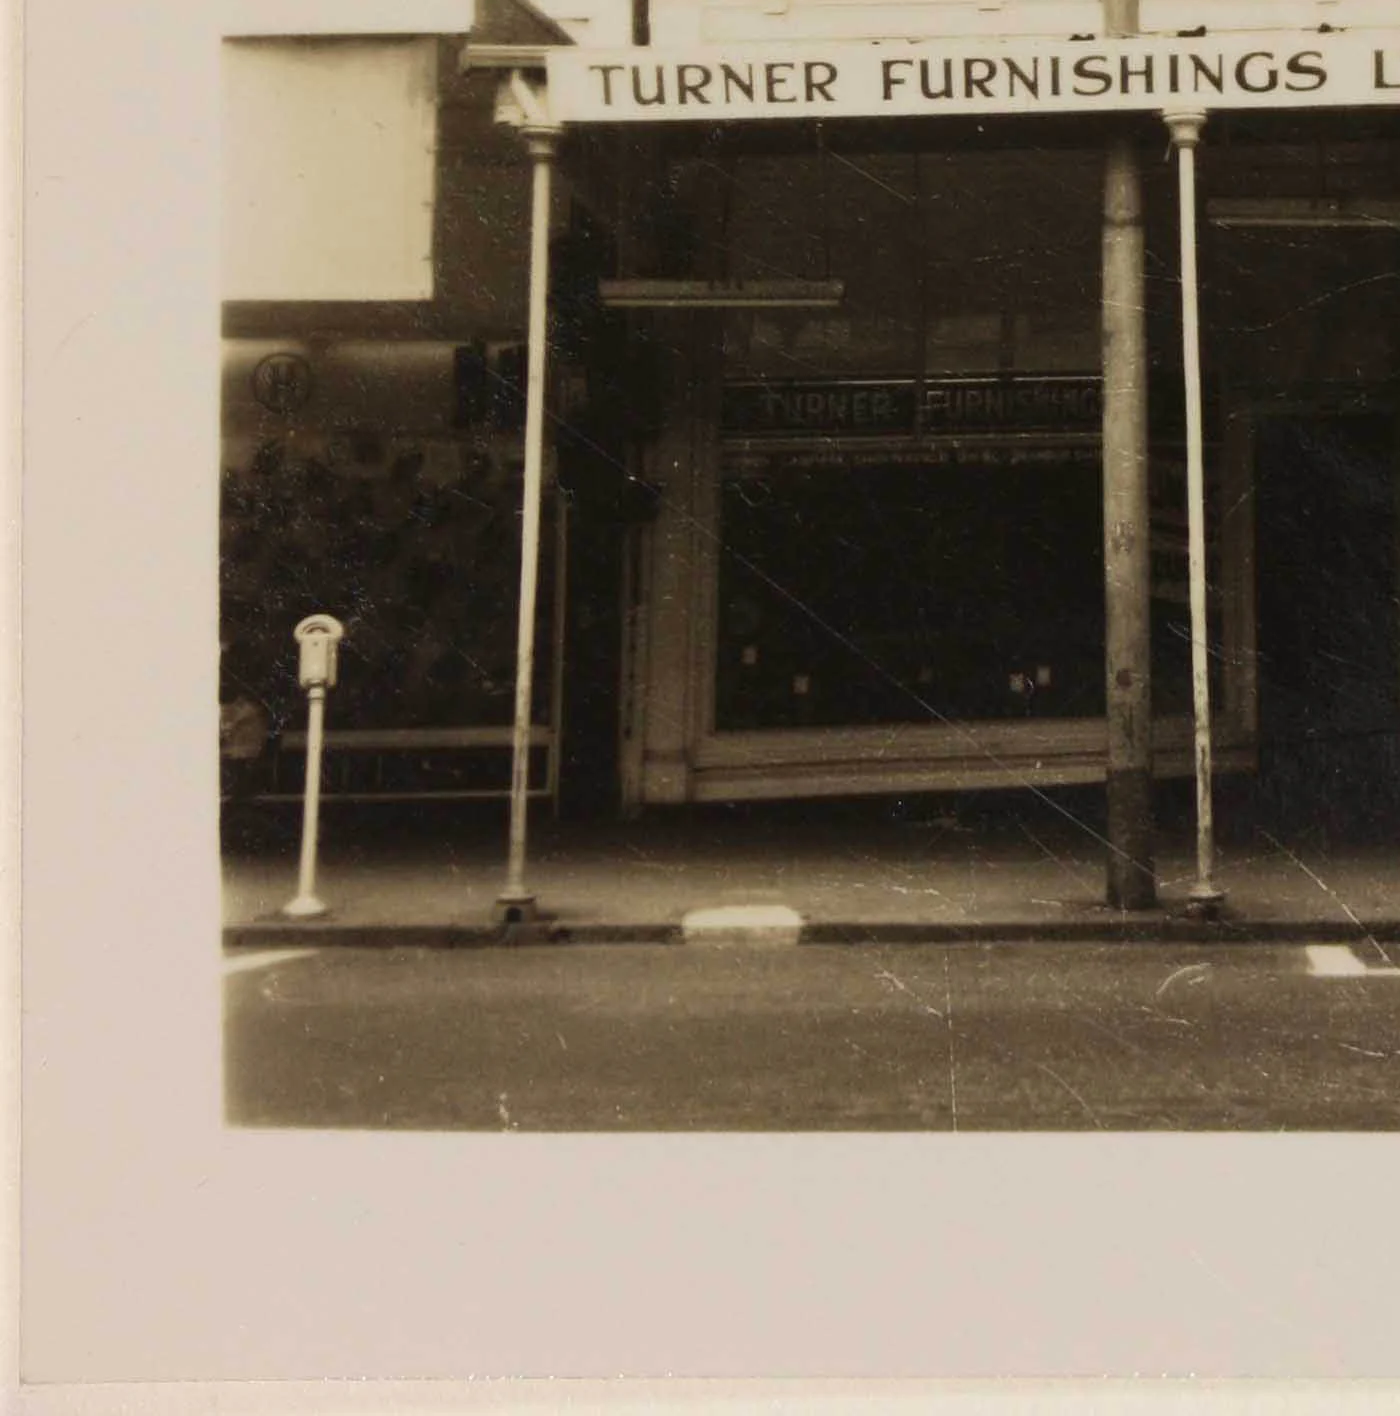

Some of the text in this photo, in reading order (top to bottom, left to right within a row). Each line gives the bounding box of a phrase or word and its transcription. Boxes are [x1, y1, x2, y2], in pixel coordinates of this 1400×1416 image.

[588, 61, 839, 105] TURNER
[879, 50, 1329, 100] FURNISHINGS
[757, 388, 896, 425] TURNER
